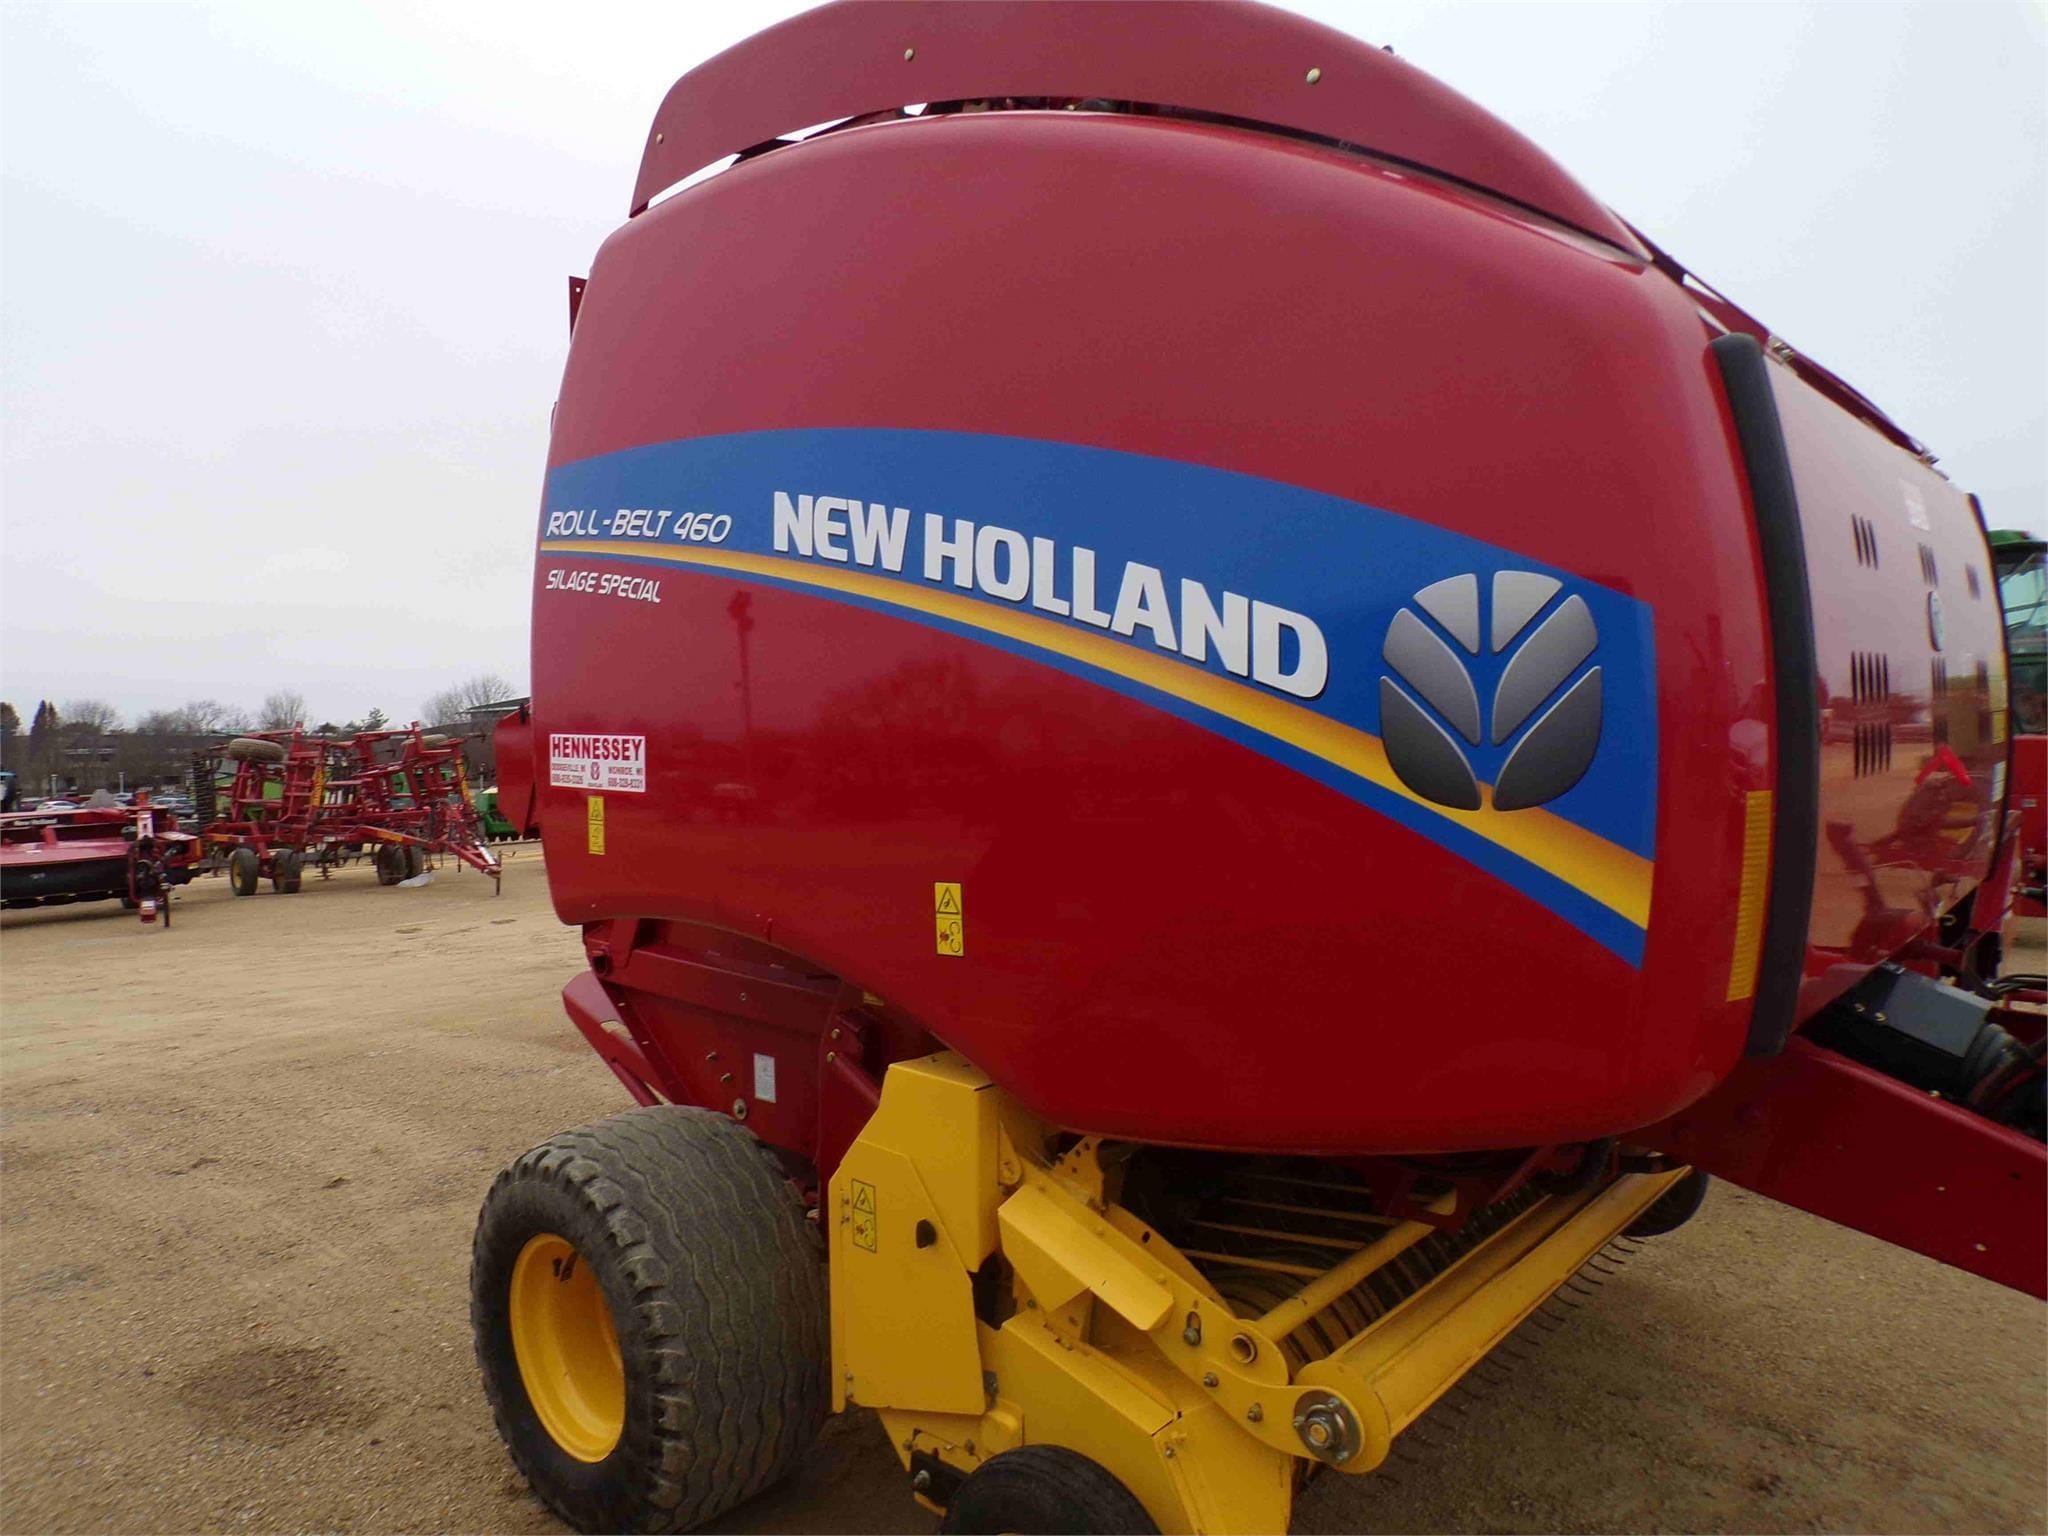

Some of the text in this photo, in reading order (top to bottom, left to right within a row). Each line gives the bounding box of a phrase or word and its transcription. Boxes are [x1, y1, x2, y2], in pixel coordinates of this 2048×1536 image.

[673, 512, 732, 543] 460
[545, 569, 661, 603] SILAGE SPECIAL
[773, 491, 1329, 699] NEW HOLLAND
[552, 737, 642, 760] HENNESSEY
